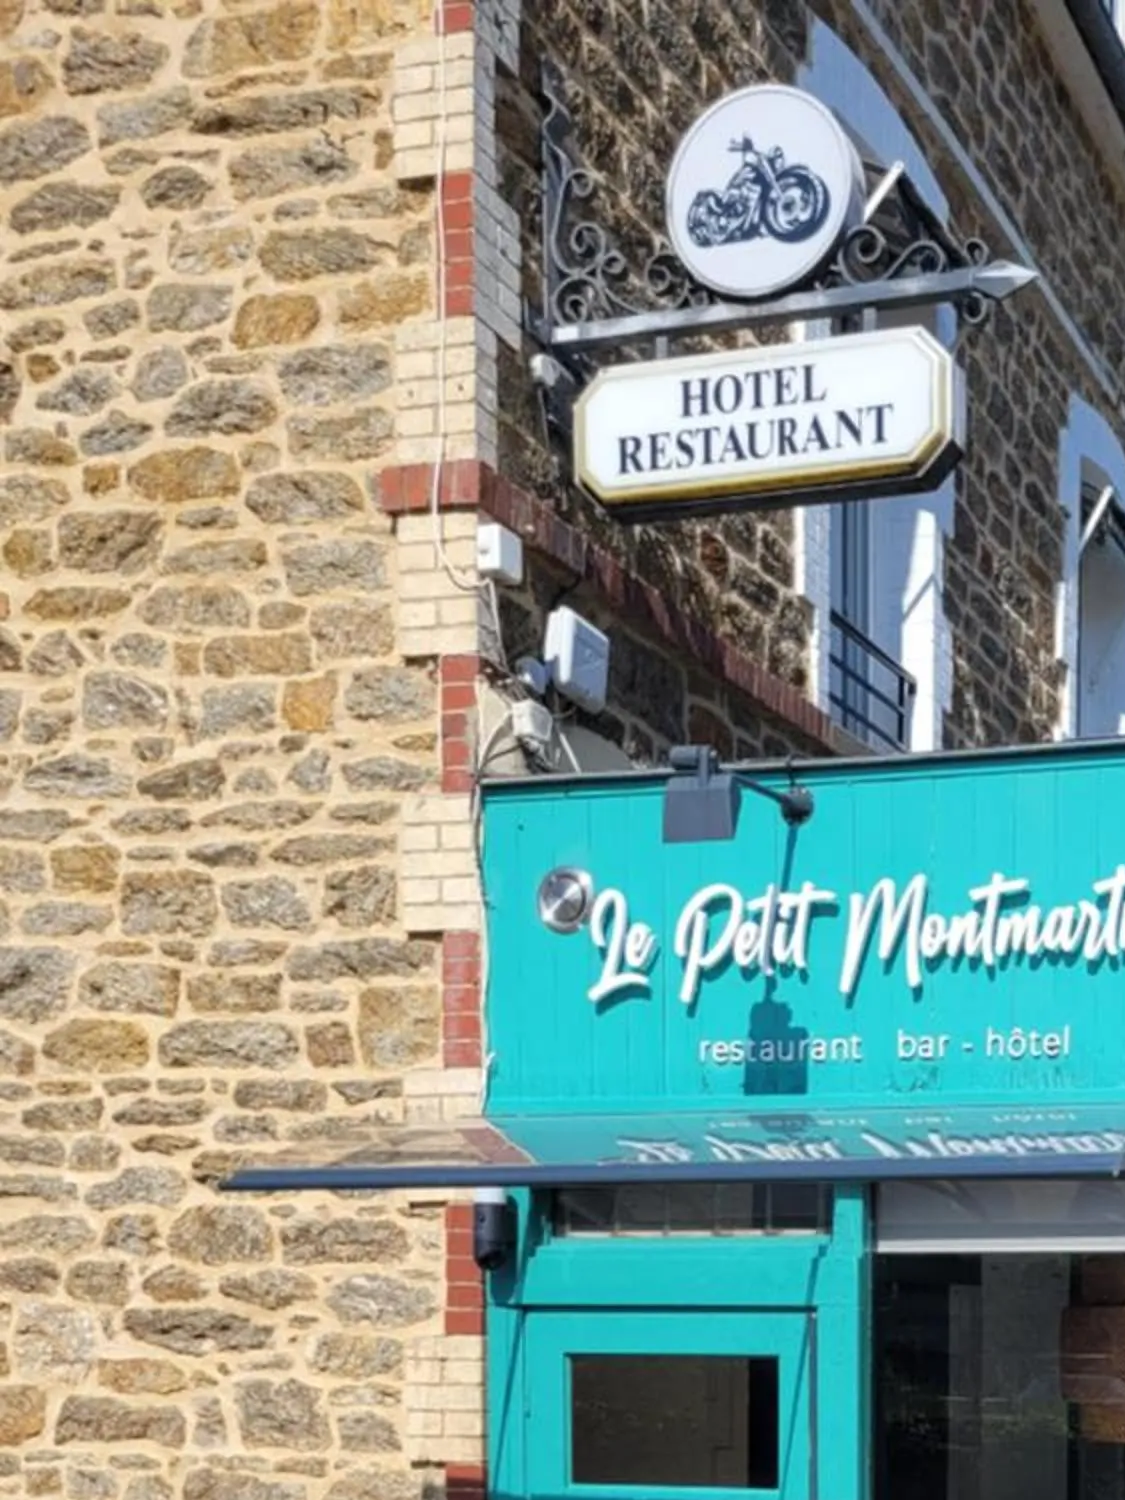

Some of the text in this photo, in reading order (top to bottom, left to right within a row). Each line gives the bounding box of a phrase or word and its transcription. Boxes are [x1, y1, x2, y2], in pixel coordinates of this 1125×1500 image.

[679, 364, 827, 418] HOTEL
[617, 404, 893, 475] RESTAURANT
[588, 889, 655, 1003] Le
[674, 884, 837, 1003] Petit
[700, 1036, 862, 1063] restaurant
[897, 1030, 950, 1062] bar
[986, 1024, 1069, 1057] hôtel
